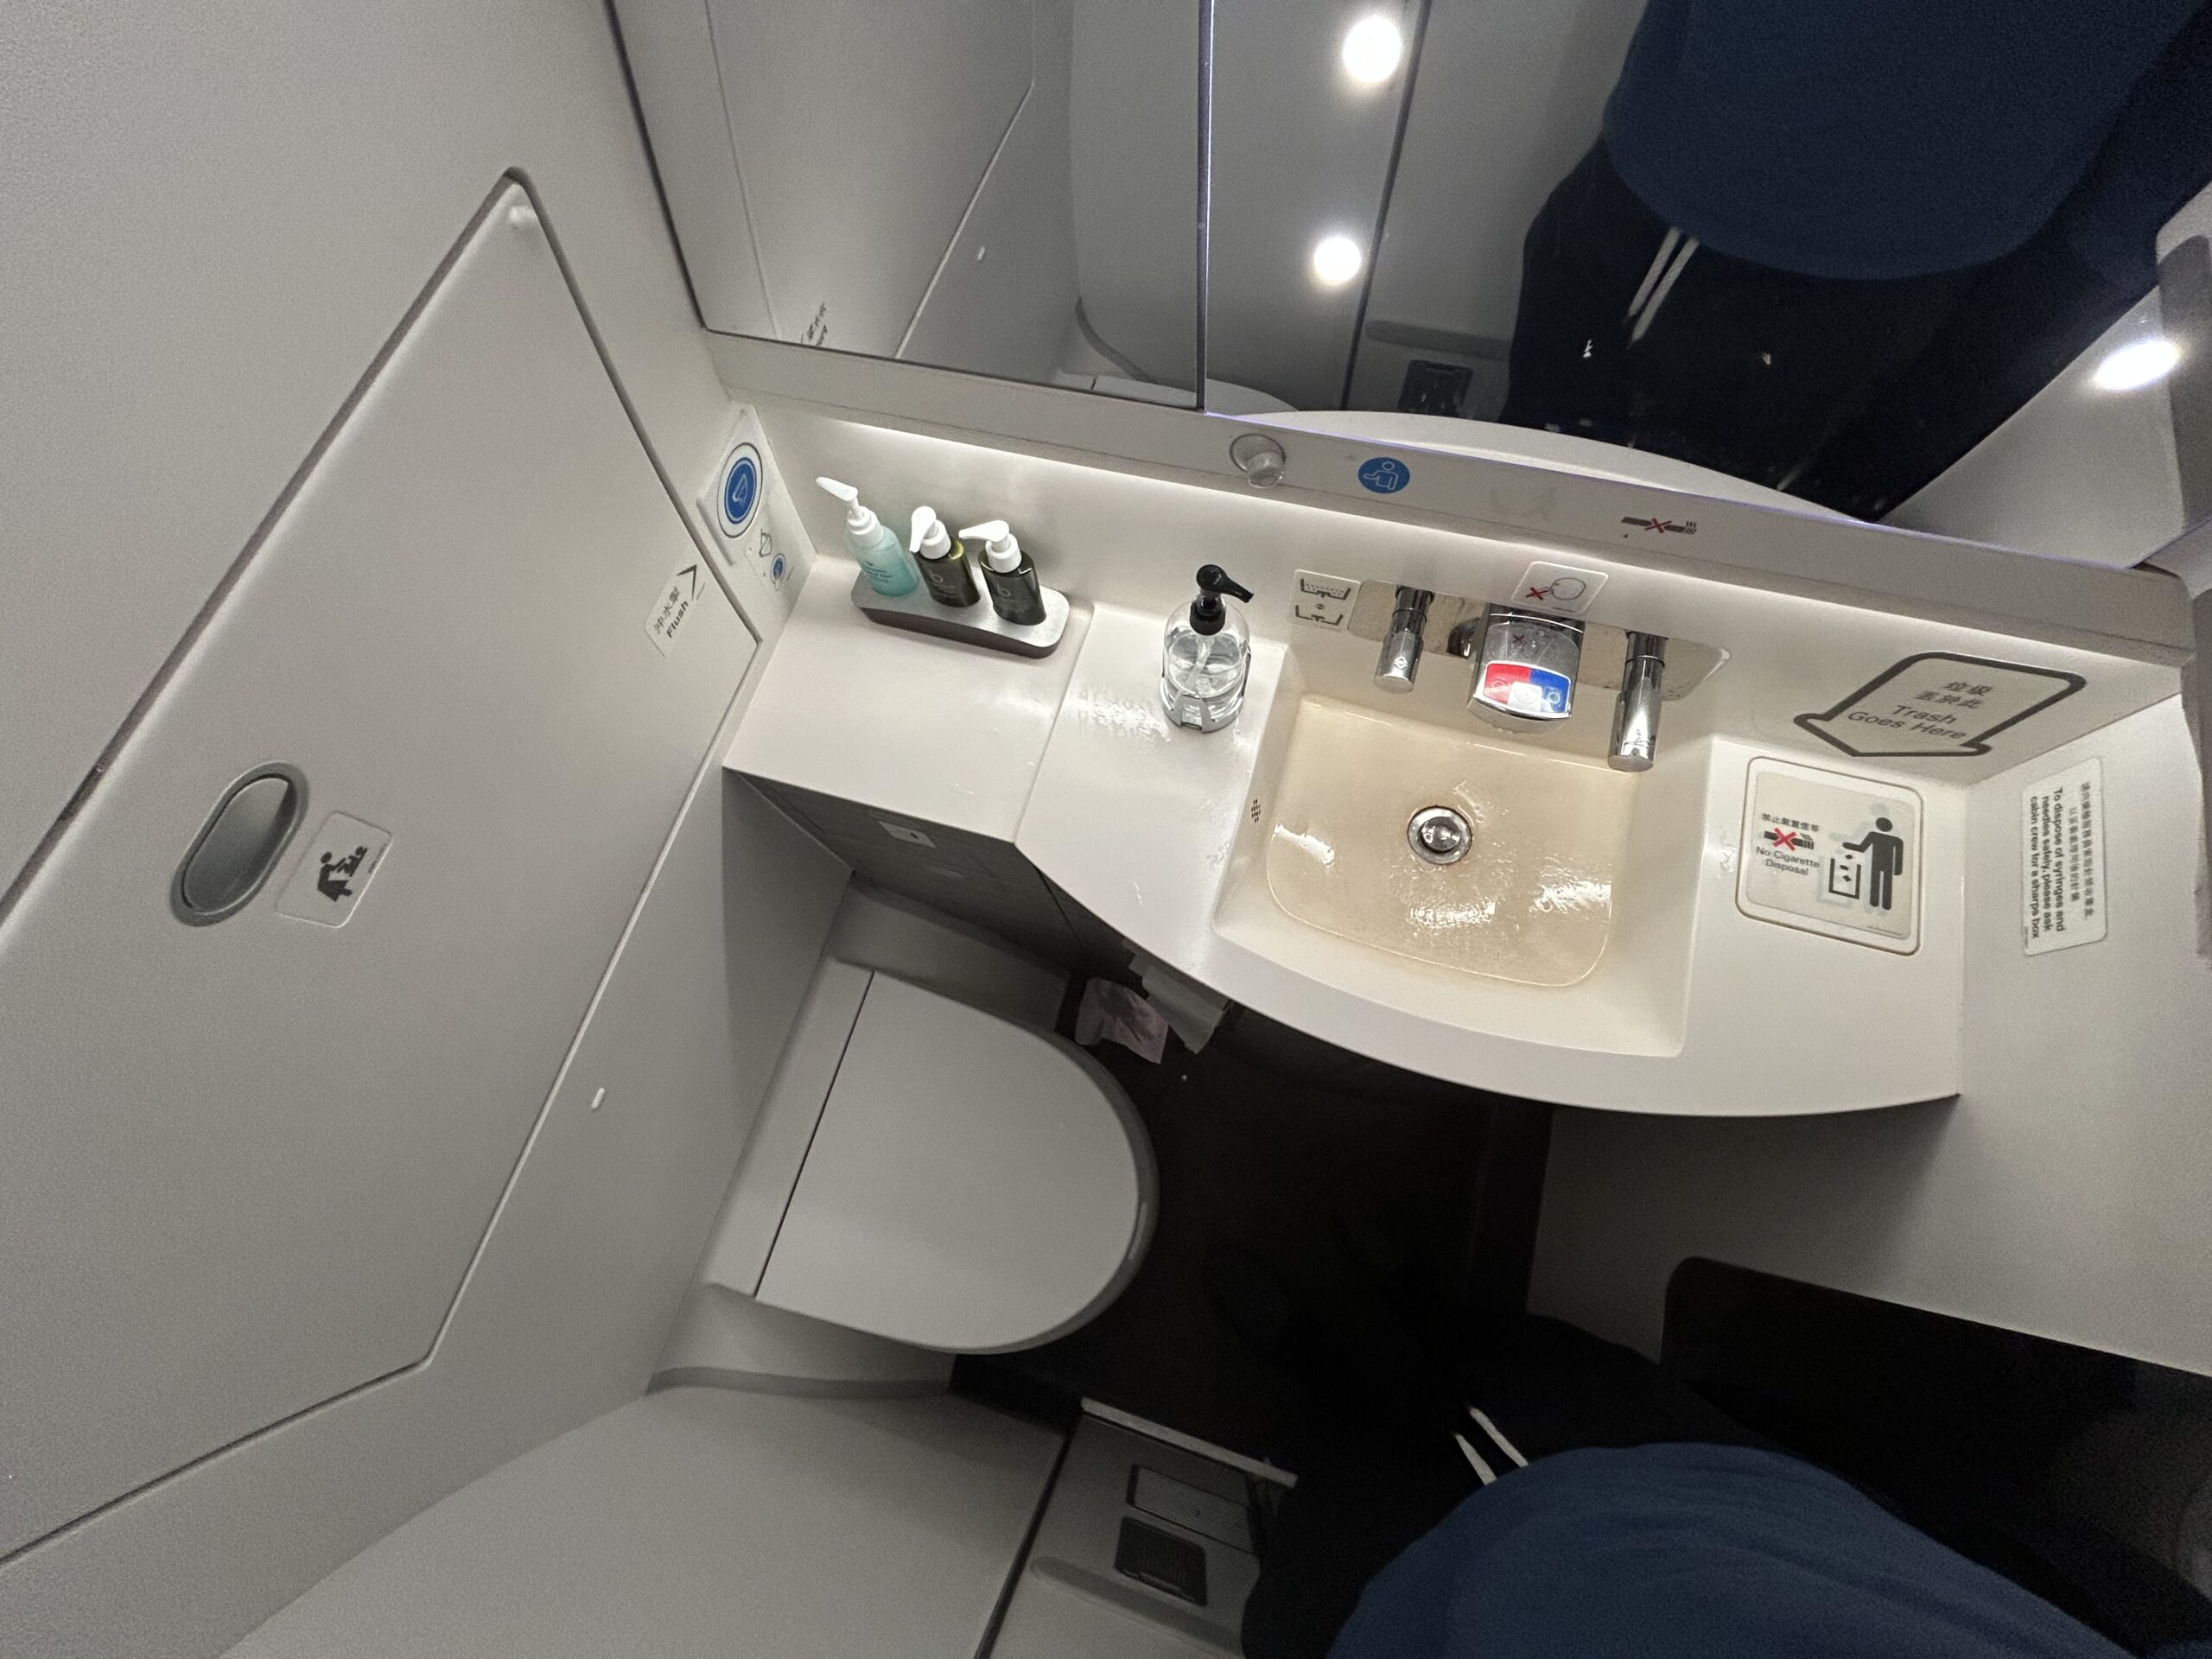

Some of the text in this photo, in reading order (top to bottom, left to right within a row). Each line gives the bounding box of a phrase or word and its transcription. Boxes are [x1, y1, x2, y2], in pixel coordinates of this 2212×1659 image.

[666, 601, 690, 639] Flush
[1847, 711, 1967, 740] Goes Here
[1892, 704, 1958, 725] Trash
[2030, 796, 2040, 825] cabin
[2042, 796, 2051, 837] needles
[2030, 826, 2039, 851] crew
[1756, 846, 1821, 868] No Cigarette
[1765, 858, 1808, 876] Disposal
[2031, 852, 2040, 868] for
[2051, 786, 2067, 932] To dispose of syringes and
[2030, 879, 2040, 917] sharps
[2042, 874, 2053, 910] please
[2031, 918, 2041, 938] box
[2043, 912, 2053, 932] ask
